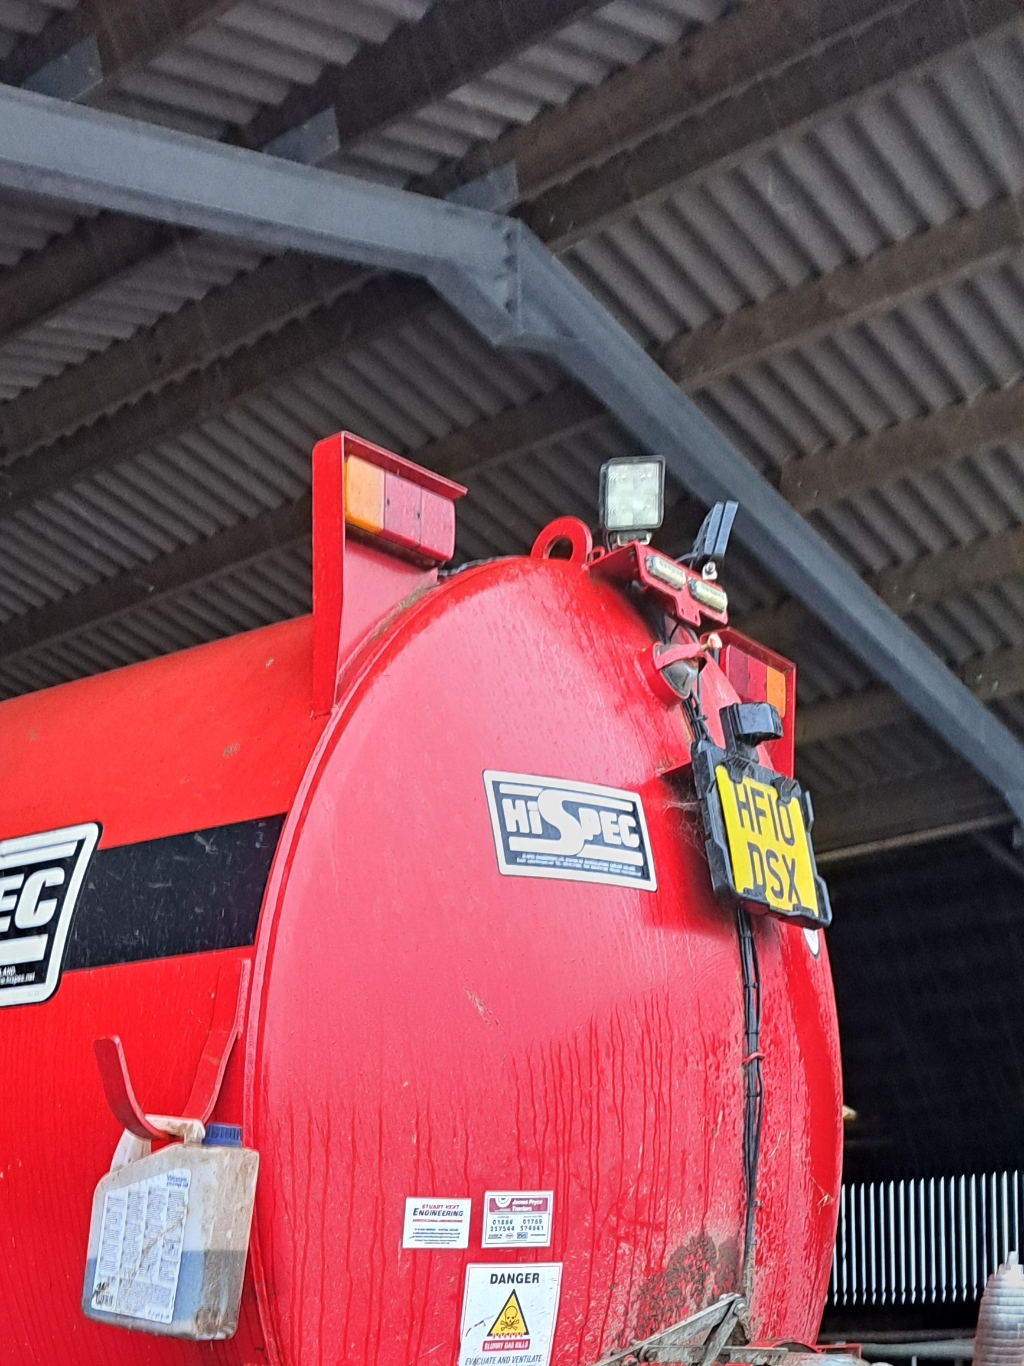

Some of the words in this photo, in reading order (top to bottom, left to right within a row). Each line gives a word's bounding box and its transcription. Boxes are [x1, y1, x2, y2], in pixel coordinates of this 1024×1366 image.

[733, 783, 795, 846] HF10
[747, 841, 802, 905] DSX
[413, 1208, 464, 1217] ENGINEERING
[490, 1273, 540, 1284] DANGER
[484, 1342, 504, 1350] SLURRY
[504, 1341, 514, 1349] GAS
[515, 1340, 529, 1349] KILLS
[464, 1357, 497, 1366] EVACUATE
[497, 1356, 510, 1364] AND
[512, 1354, 543, 1363] VENTILATE
